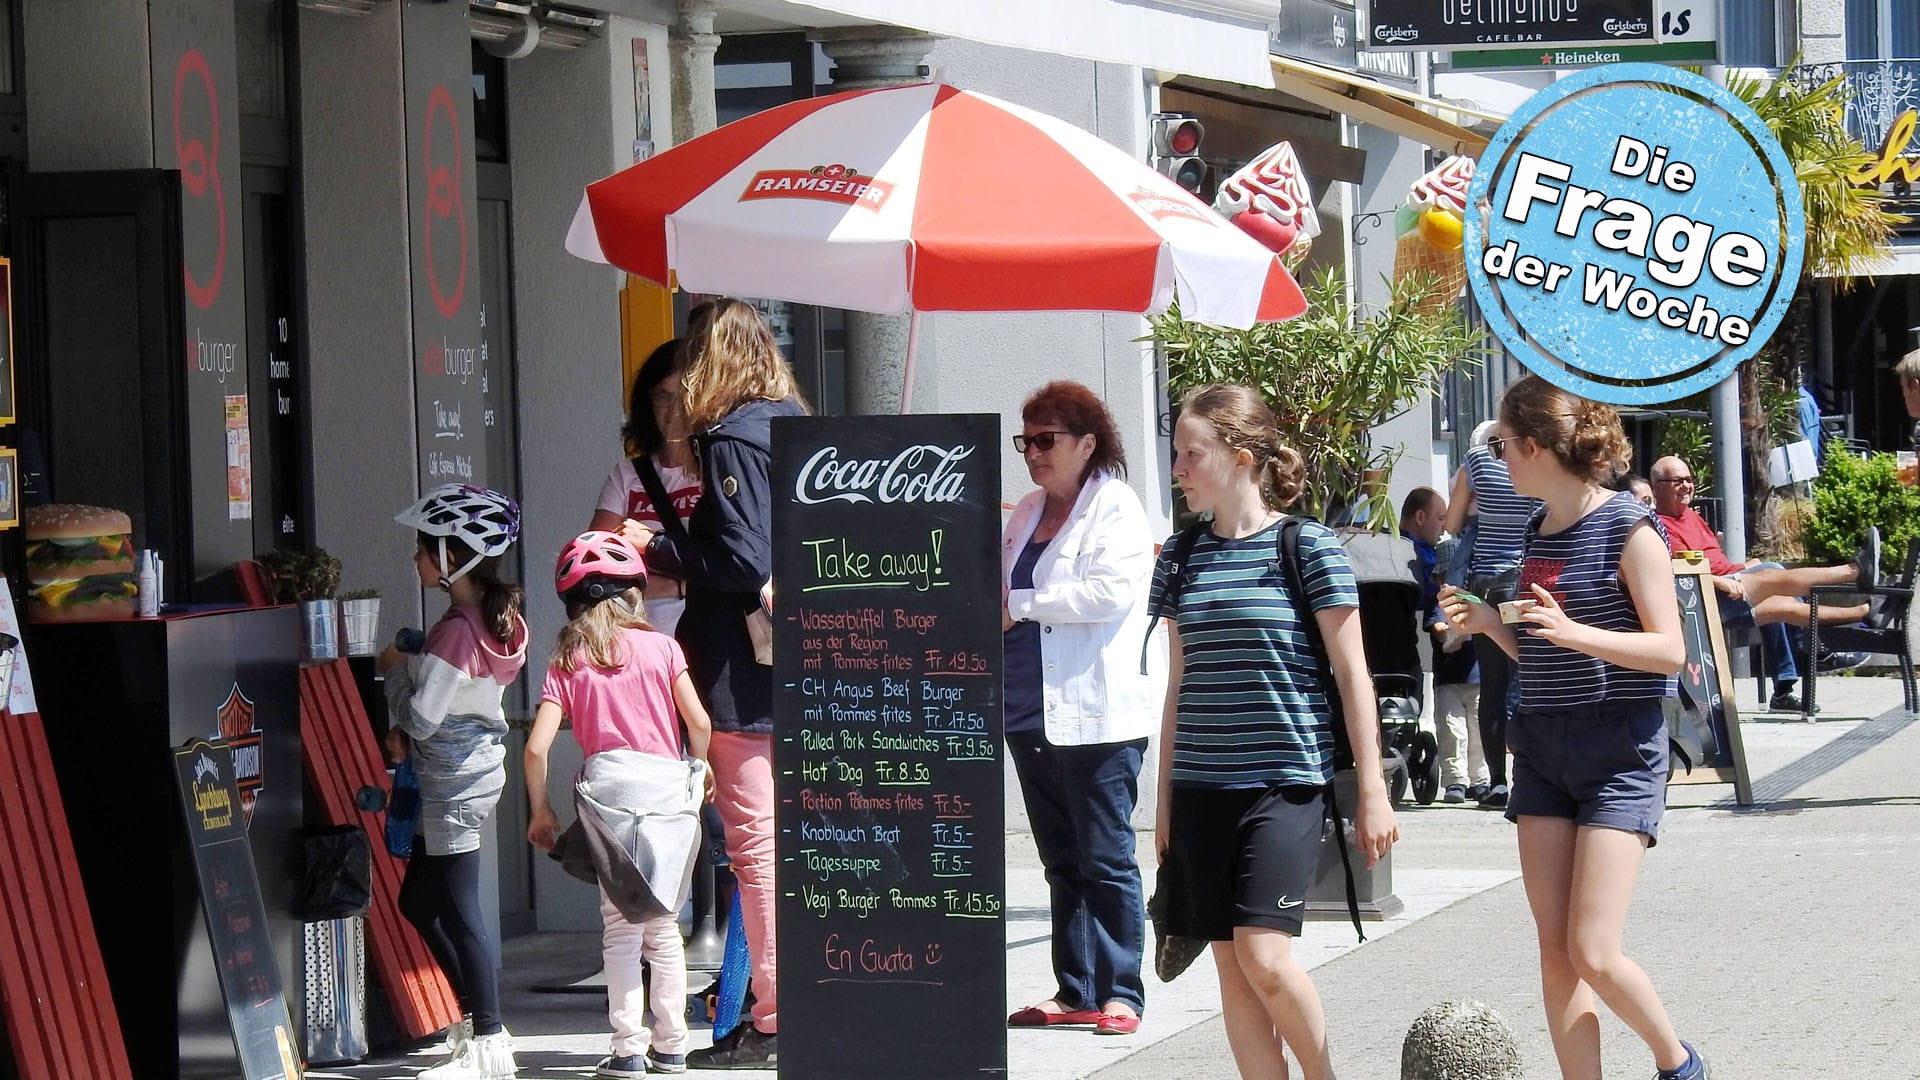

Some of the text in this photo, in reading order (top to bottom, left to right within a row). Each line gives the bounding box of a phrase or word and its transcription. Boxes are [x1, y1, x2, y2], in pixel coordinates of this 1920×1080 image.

[1374, 24, 1419, 43] Carlsberg
[1603, 17, 1648, 37] Carlsberg
[1554, 52, 1620, 64] Heineken
[753, 176, 884, 203] RAMSEIER
[792, 445, 976, 505] Coca-Cola
[802, 538, 872, 579] Take
[800, 607, 938, 637] Wasserbüffel Burger
[803, 633, 888, 656] aus der Region
[803, 653, 823, 671] mit
[831, 652, 879, 671] Pommes
[881, 653, 913, 675] frites
[948, 651, 987, 671] 19.50
[802, 676, 965, 710] CH Angus Beef Burger
[804, 704, 823, 721] mit
[828, 702, 877, 722] Pommes
[880, 704, 912, 728] frites
[948, 711, 984, 730] 17.50
[800, 729, 835, 751] Pulled
[839, 729, 866, 750] Pork
[871, 730, 940, 752] Sandwiches
[802, 759, 828, 783] Hot
[837, 761, 863, 787] Dog
[899, 762, 930, 781] 8.50
[800, 788, 842, 811] Portion
[846, 790, 892, 812] Pommes
[894, 792, 925, 815] frites
[801, 820, 866, 842] Knoblauch
[871, 824, 901, 843] Brot
[800, 848, 881, 881] Tagessuppe
[802, 884, 831, 918] Vegi
[836, 888, 880, 918] Burger
[888, 888, 937, 908] Pommes
[964, 892, 1000, 912] 15.50
[825, 933, 913, 972] En Guata
